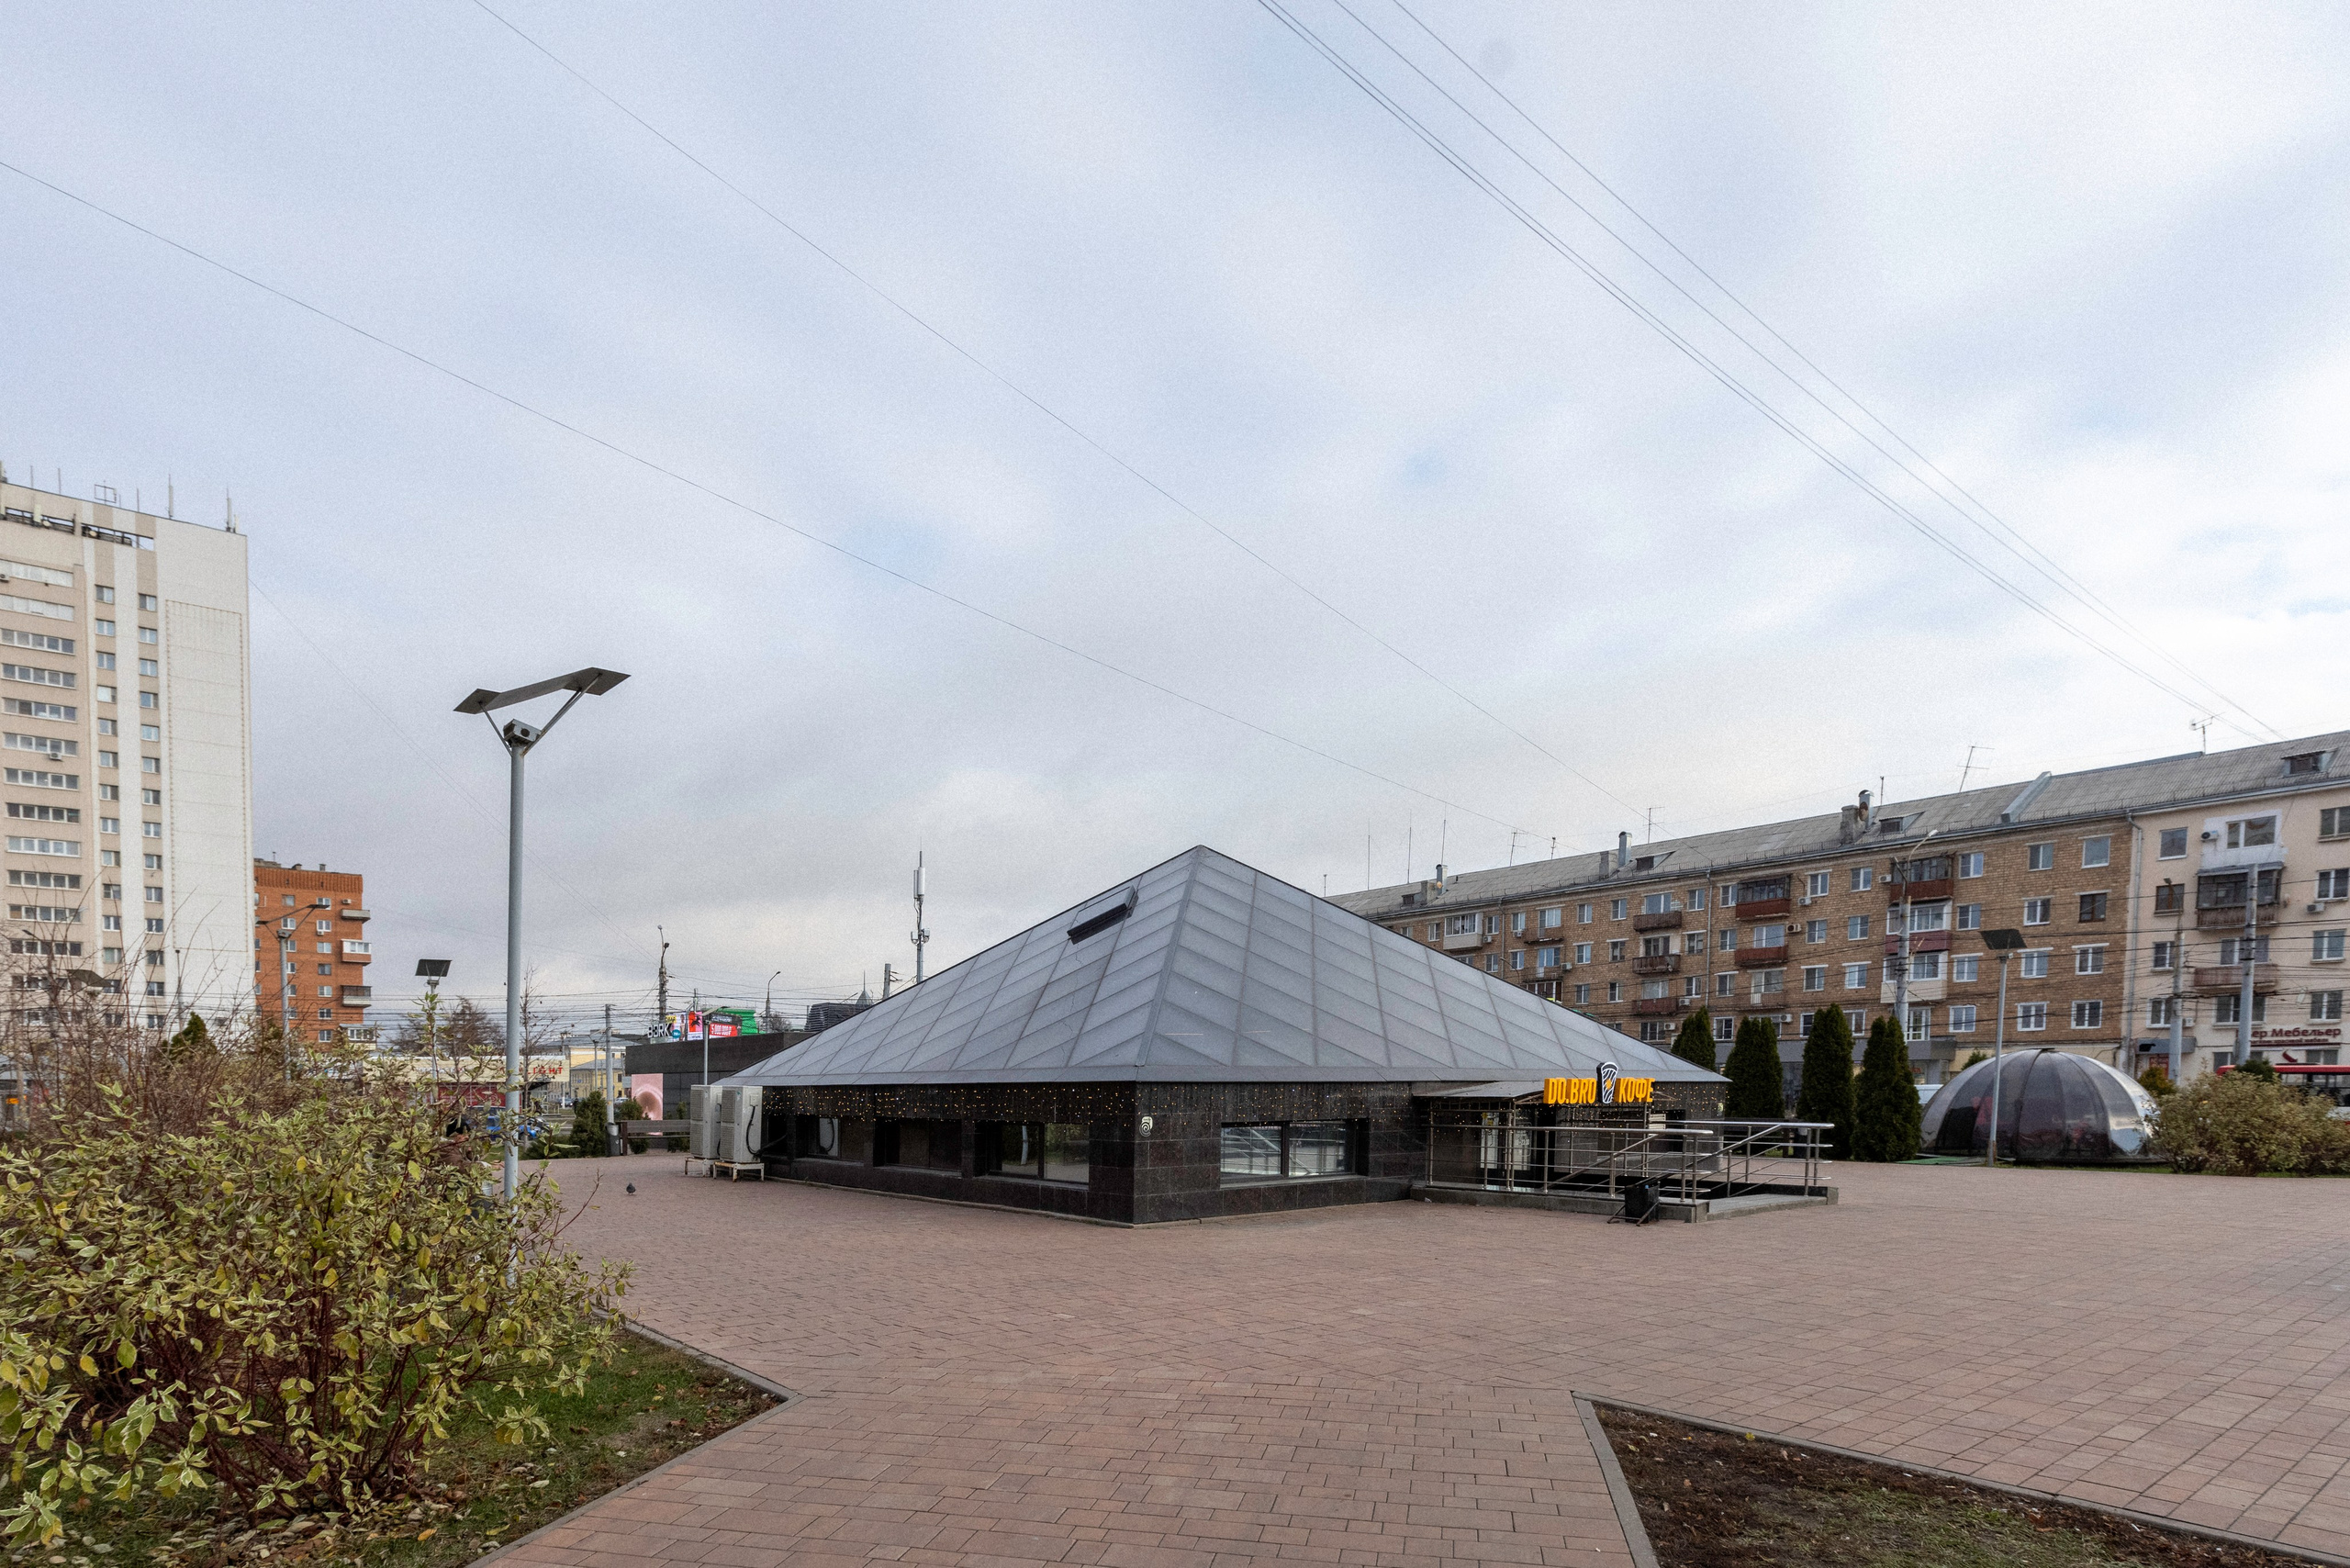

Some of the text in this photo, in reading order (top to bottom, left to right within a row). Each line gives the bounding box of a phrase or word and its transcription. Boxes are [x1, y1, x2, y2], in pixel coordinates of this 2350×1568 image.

[2271, 1027, 2342, 1038] Мебельер
[1545, 1078, 1655, 1104] DO.BRO КОФЕ
